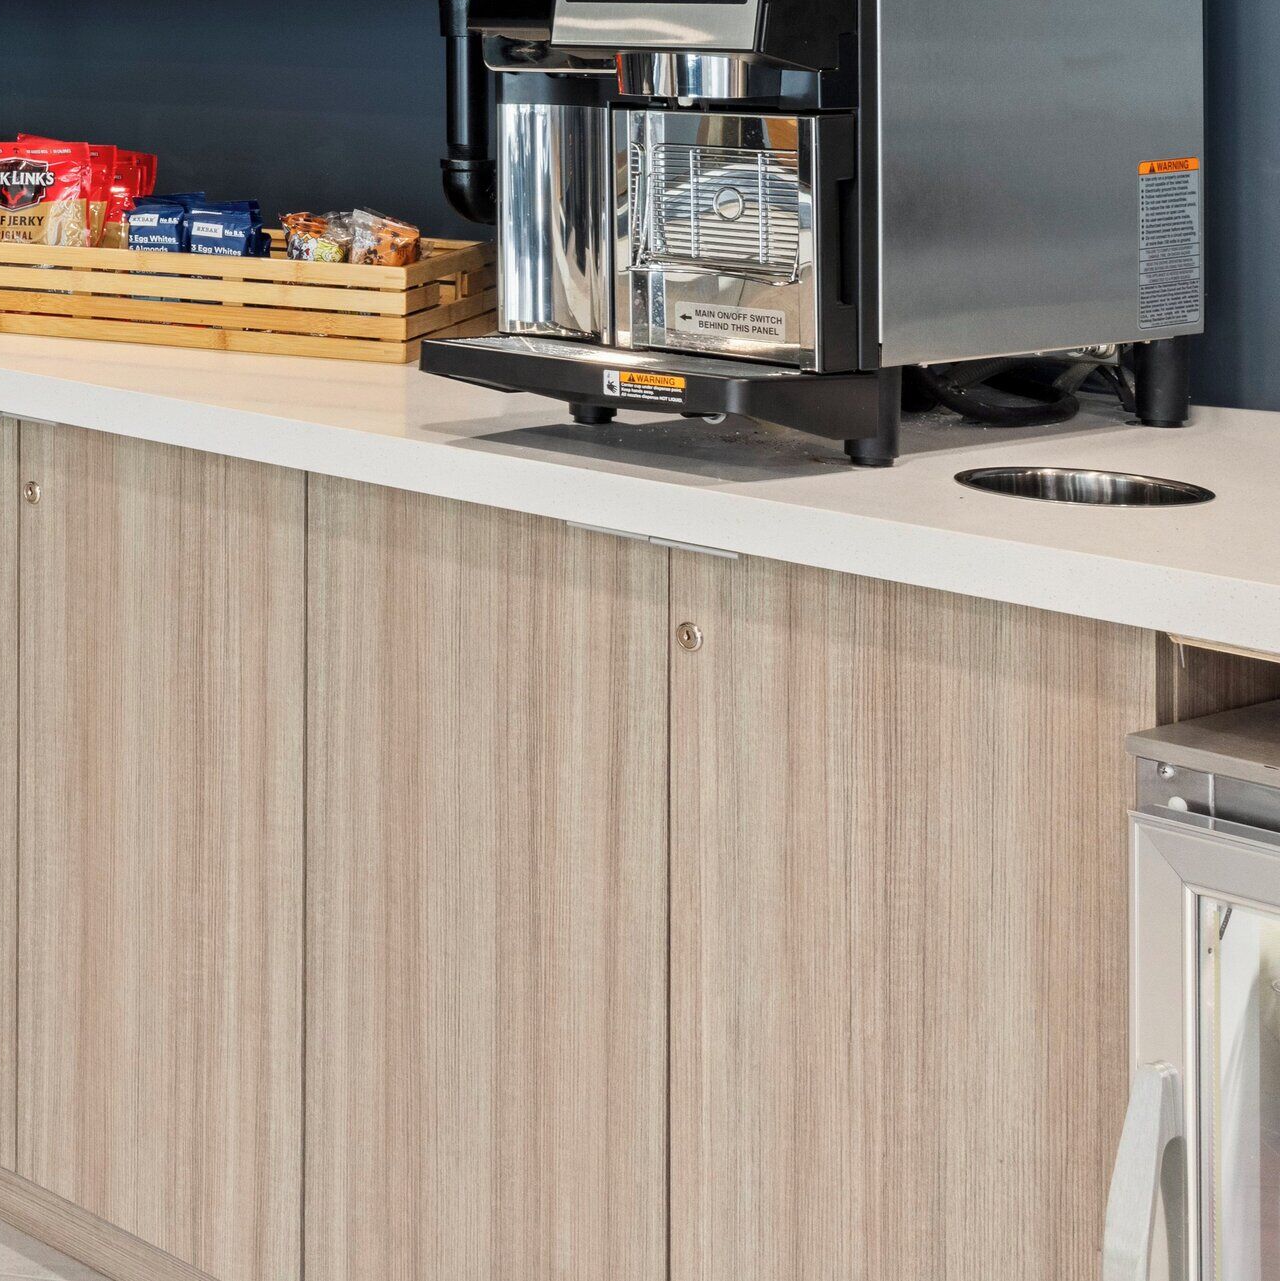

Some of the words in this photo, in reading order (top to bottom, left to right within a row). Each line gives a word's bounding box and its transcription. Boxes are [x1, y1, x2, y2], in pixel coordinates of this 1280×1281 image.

[1157, 160, 1189, 171] WARNING
[12, 171, 55, 187] LINK'S
[8, 215, 45, 226] JERKY
[134, 235, 148, 243] Egg
[148, 235, 176, 243] Whites
[197, 245, 213, 254] Egg
[214, 246, 242, 256] Whites
[694, 309, 715, 319] MAIN
[717, 311, 748, 321] ON/OFF
[749, 314, 783, 325] SWITCH
[698, 320, 729, 331] BEHIND
[731, 324, 750, 333] THIS
[751, 326, 779, 336] PANEL
[636, 375, 676, 386] WARNING
